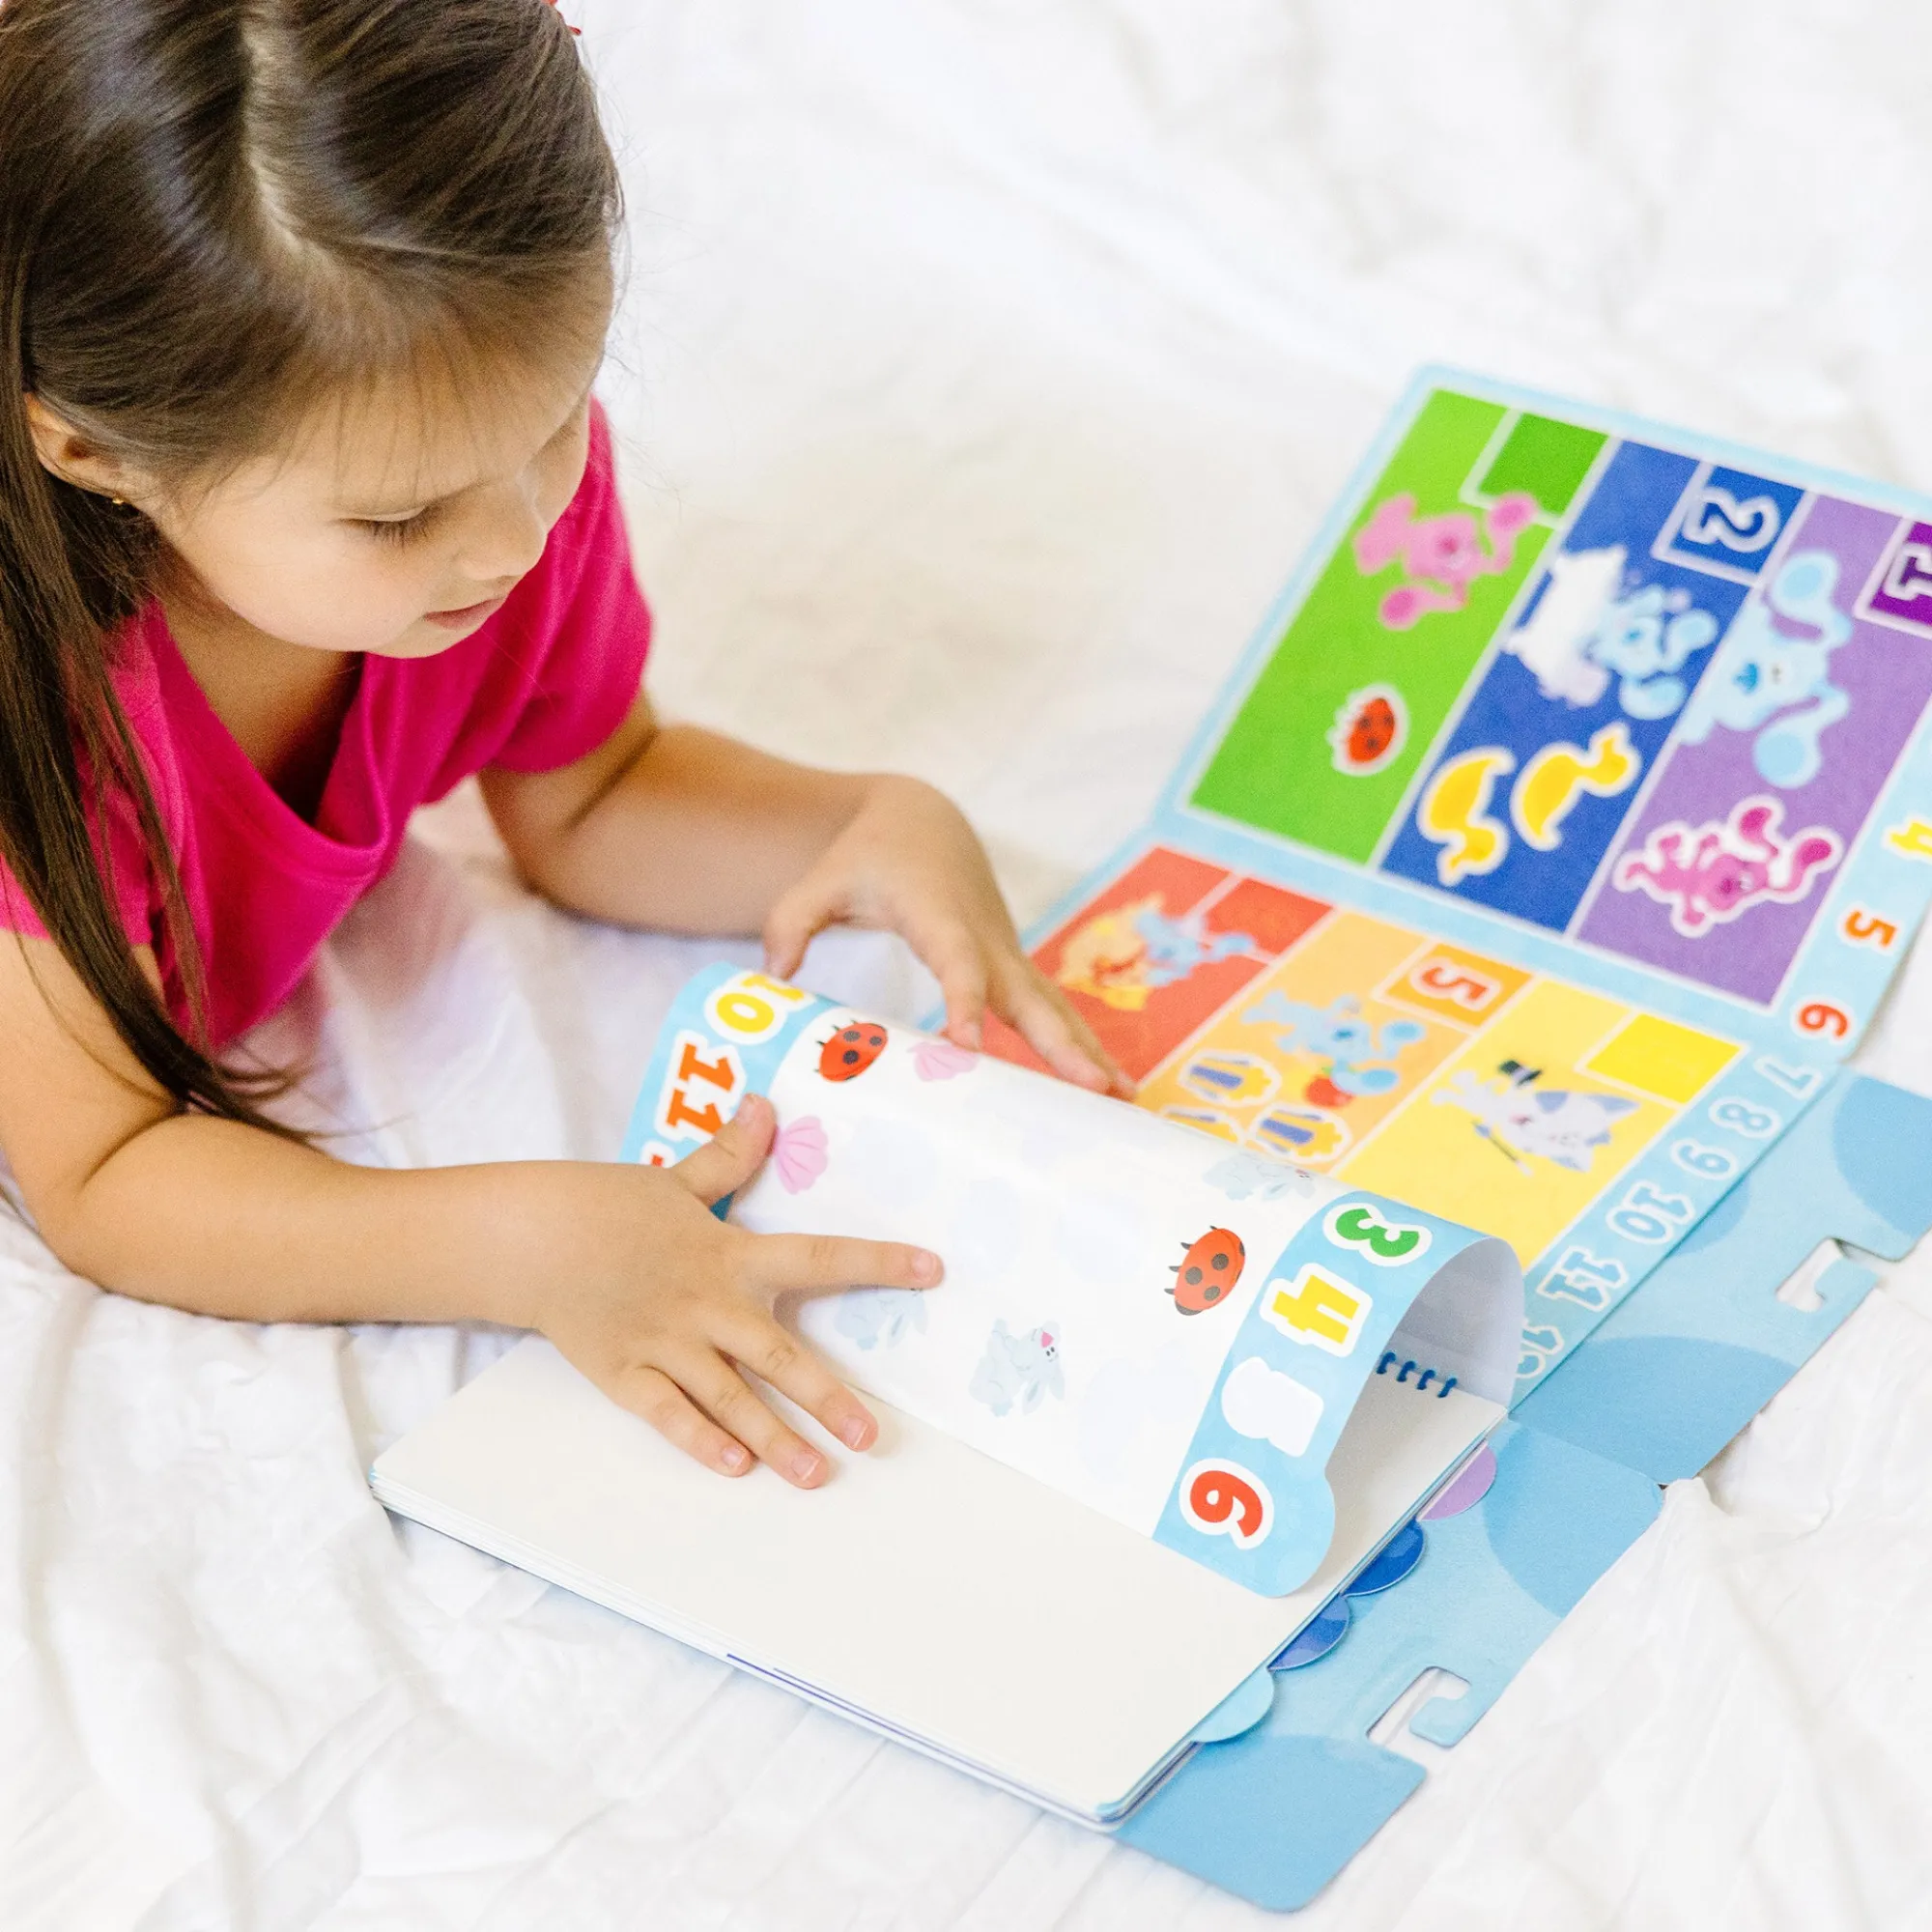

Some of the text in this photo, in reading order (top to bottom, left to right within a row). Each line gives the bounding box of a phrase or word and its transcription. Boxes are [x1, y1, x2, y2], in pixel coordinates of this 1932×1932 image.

[1691, 494, 1772, 546] 2
[1795, 818, 1932, 1042] 4 5 6
[1415, 962, 1494, 1008] 5
[661, 973, 810, 1140] 10 11
[1755, 1059, 1820, 1097] 7
[1710, 1097, 1779, 1136] 8
[1673, 1140, 1736, 1179] 9
[1607, 1182, 1693, 1242] 10
[1538, 1247, 1627, 1310] 11
[1184, 1206, 1426, 1544] 3 4 6
